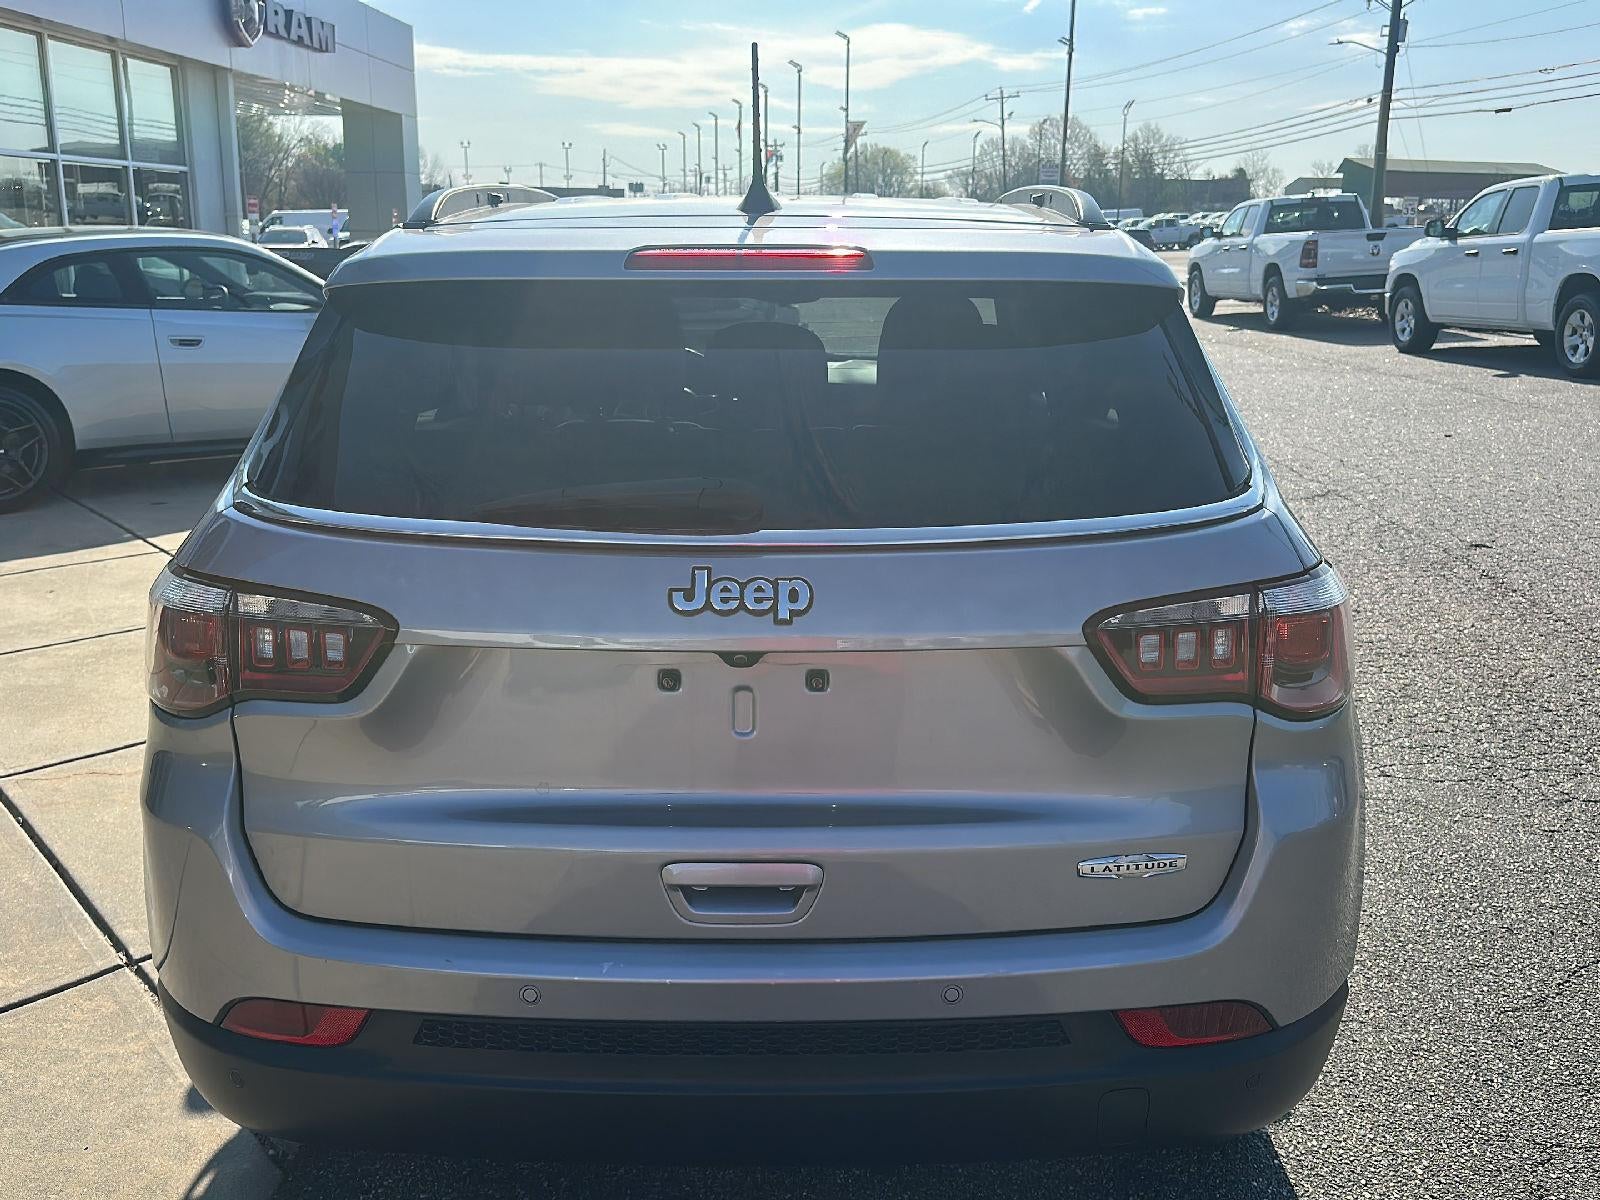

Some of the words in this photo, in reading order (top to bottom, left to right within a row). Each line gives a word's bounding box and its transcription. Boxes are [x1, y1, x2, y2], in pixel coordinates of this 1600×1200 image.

[266, 0, 335, 53] RAM
[1403, 207, 1416, 215] 35
[668, 565, 813, 625] Jeep
[1090, 860, 1178, 873] LATITUDE
